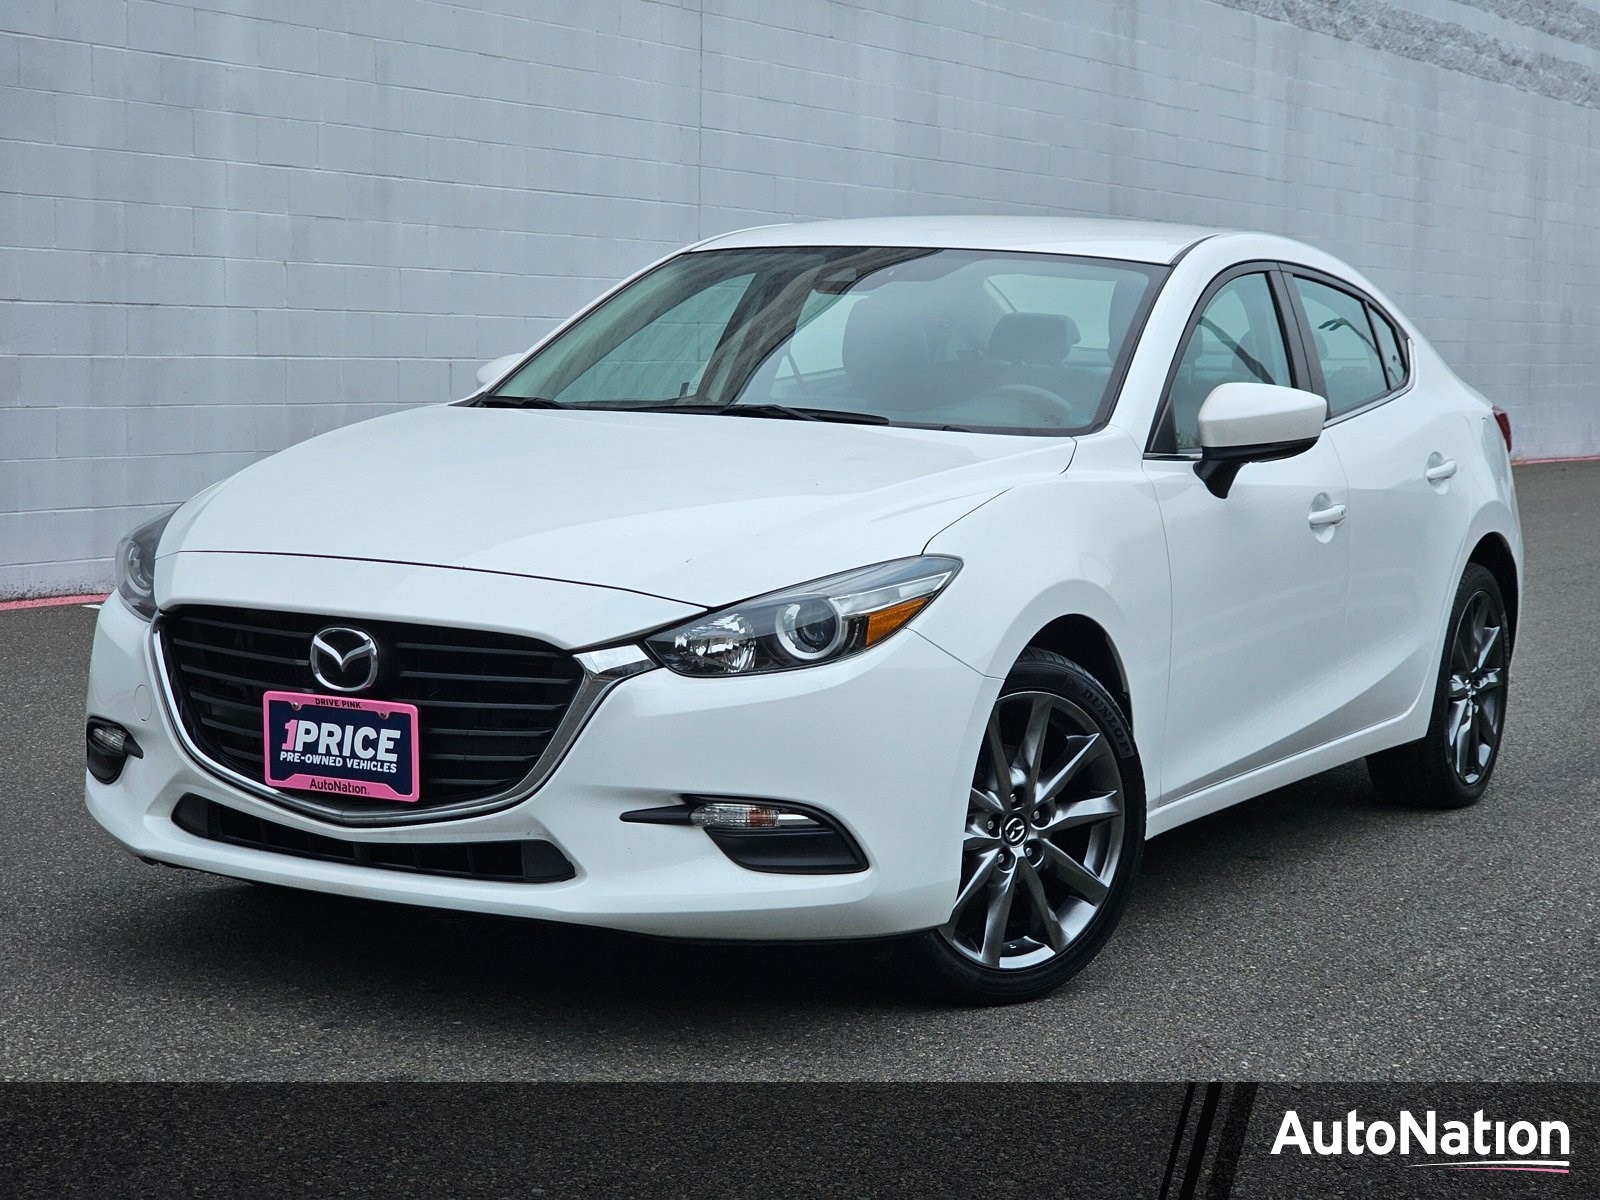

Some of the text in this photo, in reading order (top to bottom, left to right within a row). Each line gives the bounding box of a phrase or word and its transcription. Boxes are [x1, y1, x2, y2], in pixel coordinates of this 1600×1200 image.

[315, 698, 361, 709] DRIVE PINK
[1080, 688, 1130, 752] DUNLOP
[281, 719, 401, 762] 1PRICE
[280, 751, 397, 774] PRE-OWNED VEHICLES
[309, 778, 367, 795] AutoNation
